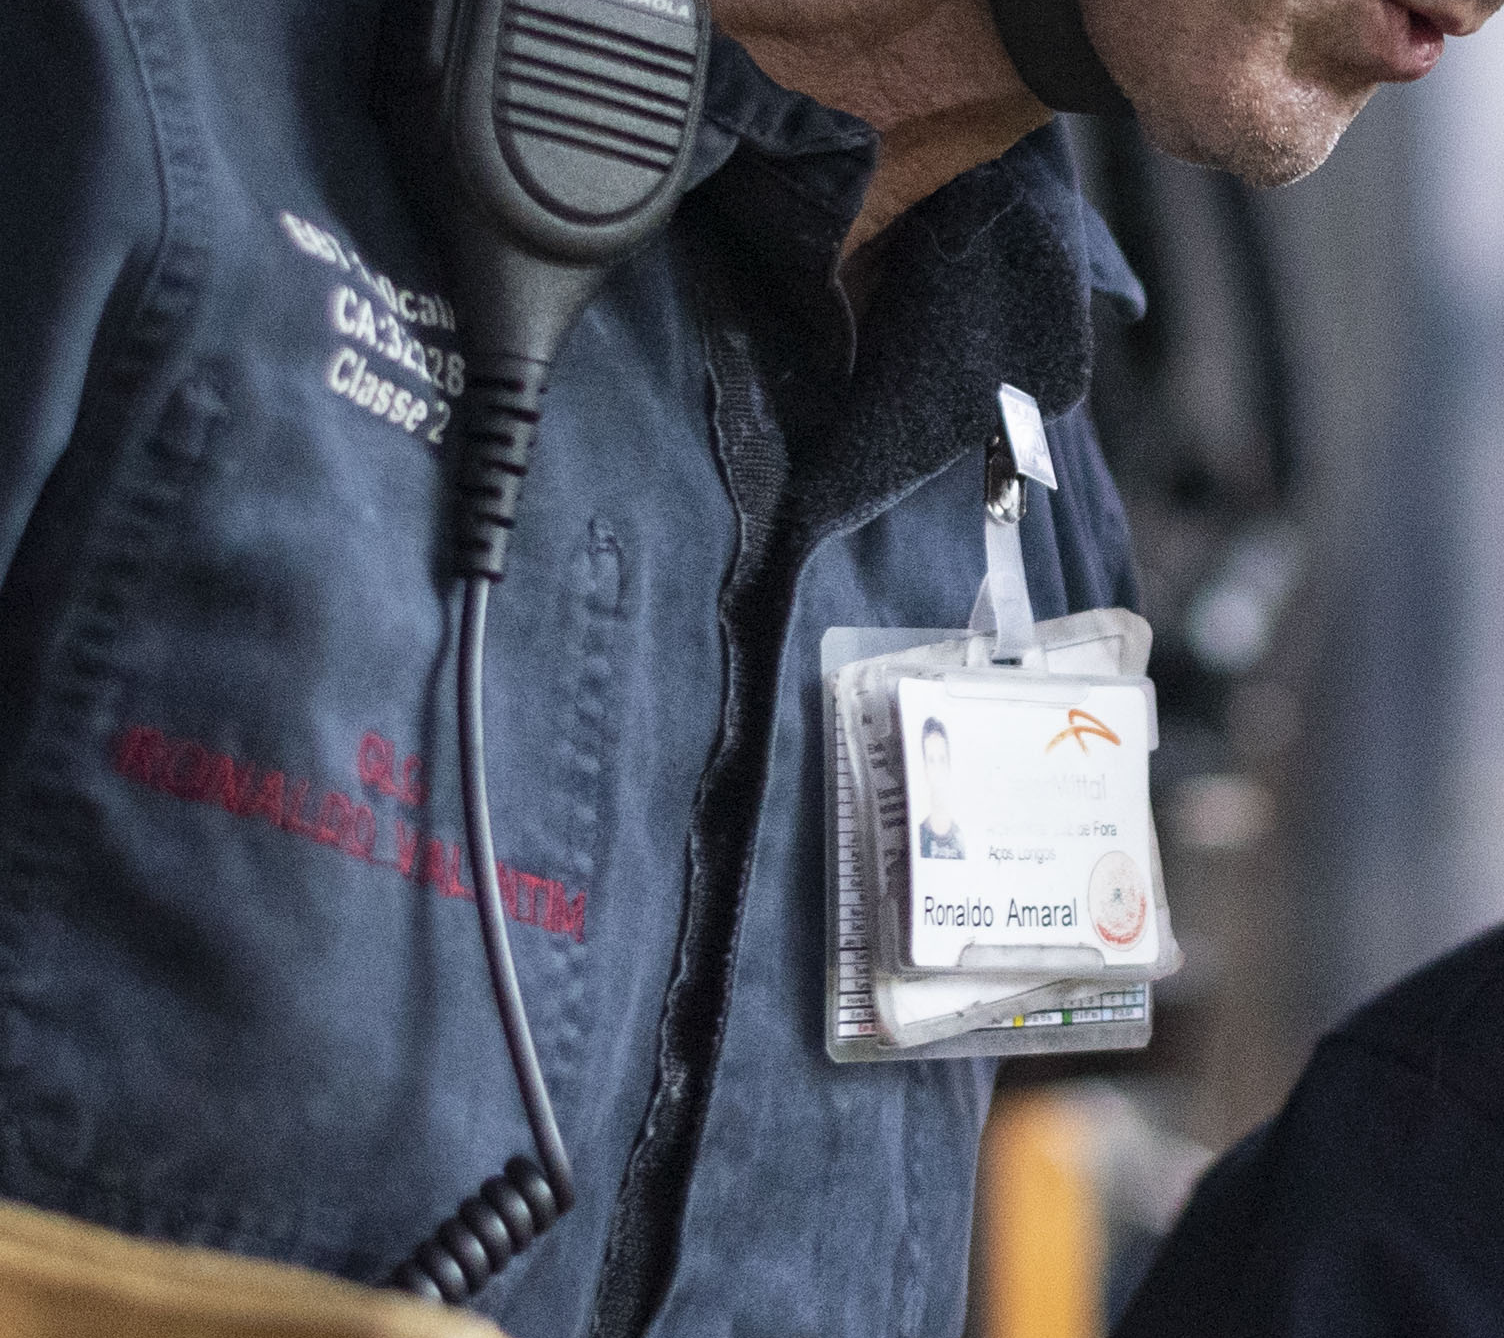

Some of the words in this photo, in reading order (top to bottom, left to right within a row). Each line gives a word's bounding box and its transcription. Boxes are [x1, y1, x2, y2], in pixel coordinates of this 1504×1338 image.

[328, 347, 428, 433] Classe
[426, 400, 452, 444] 2
[116, 726, 377, 863] RONALDO
[1094, 821, 1117, 837] Fora
[394, 818, 587, 943] VALNTIM
[924, 896, 994, 927] Ronaldo
[1006, 897, 1078, 927] Amaral
